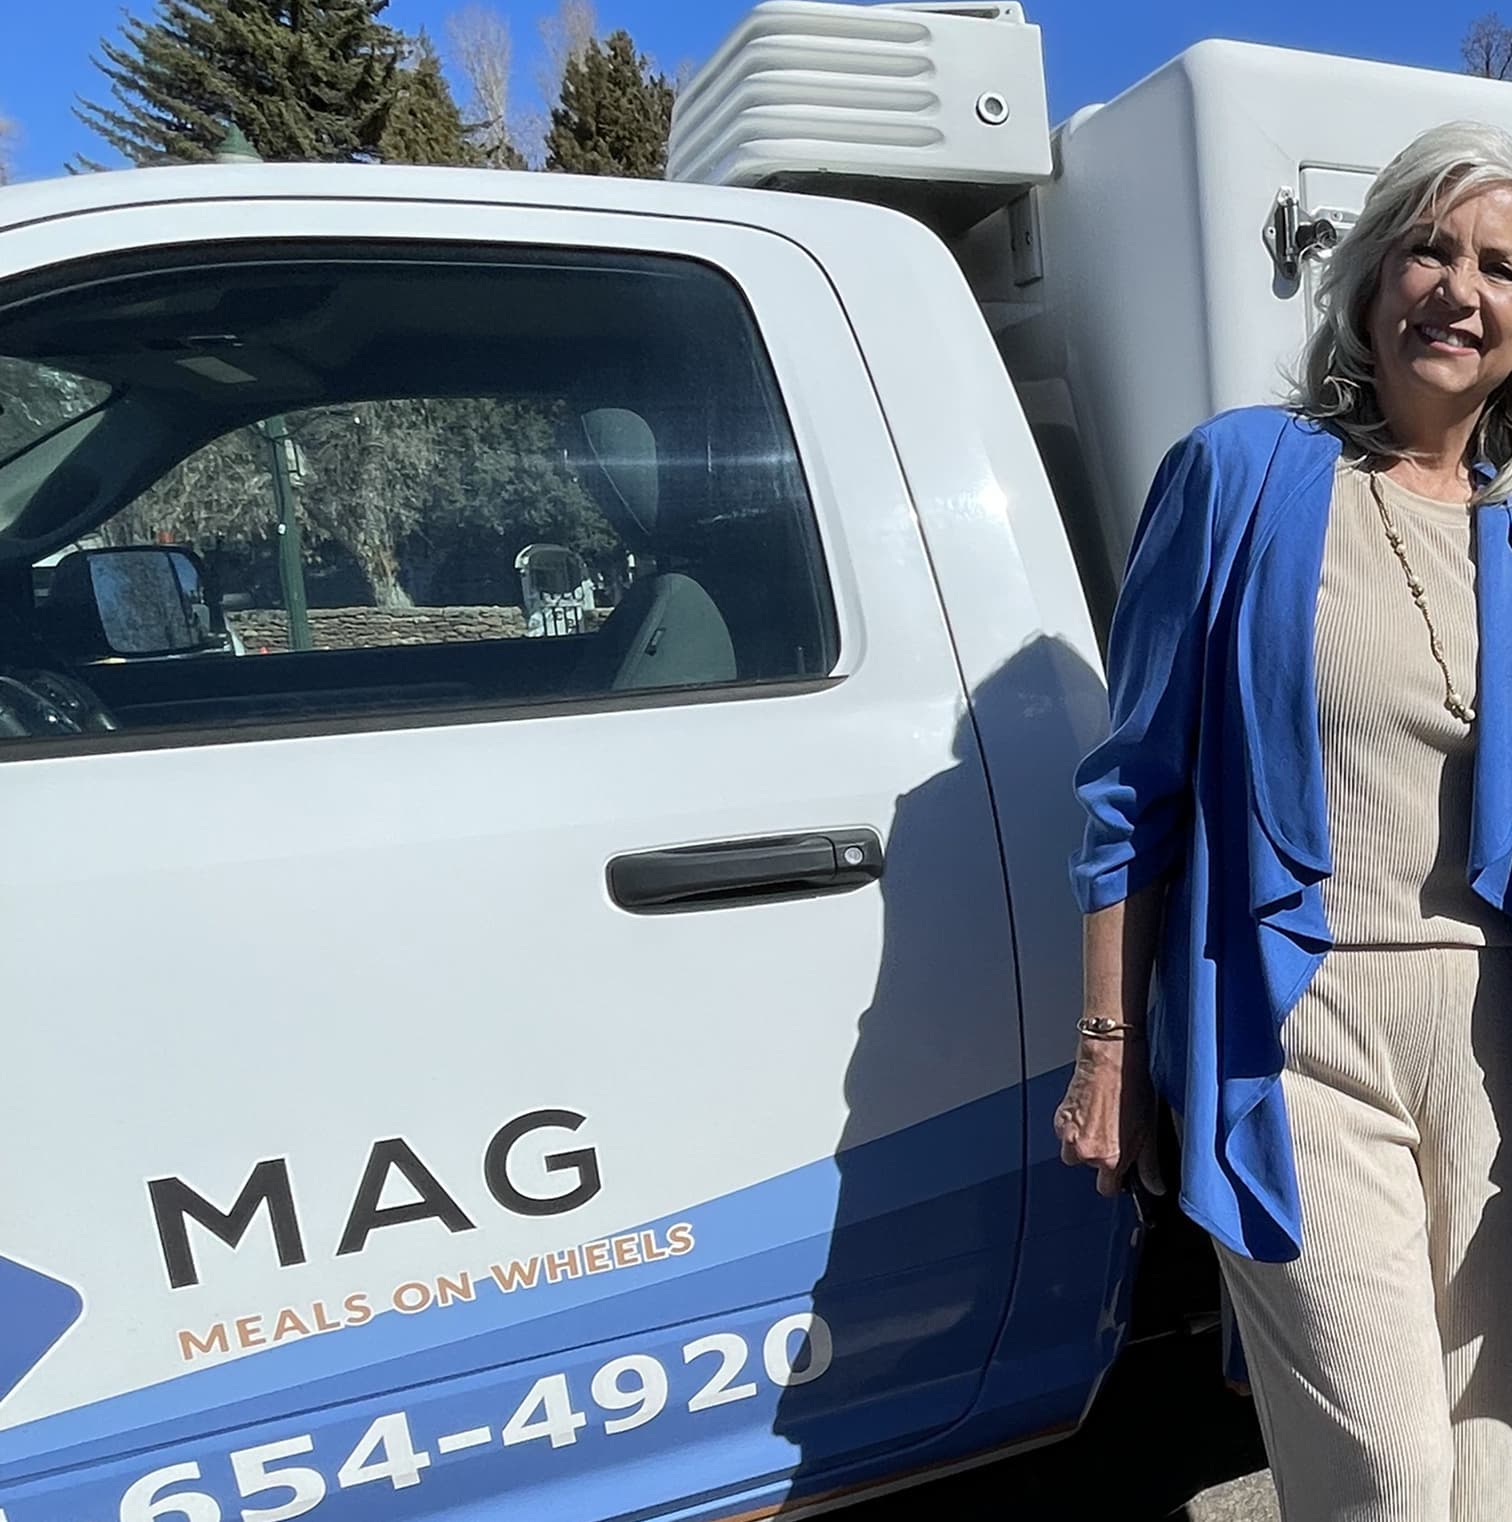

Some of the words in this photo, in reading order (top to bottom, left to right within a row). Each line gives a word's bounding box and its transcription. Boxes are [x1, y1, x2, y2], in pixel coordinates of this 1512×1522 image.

[146, 1109, 602, 1289] MAG
[178, 1293, 373, 1360] MEALS
[391, 1271, 474, 1313] ON
[490, 1224, 697, 1293] WHEELS
[118, 1312, 834, 1522] 654-4920
